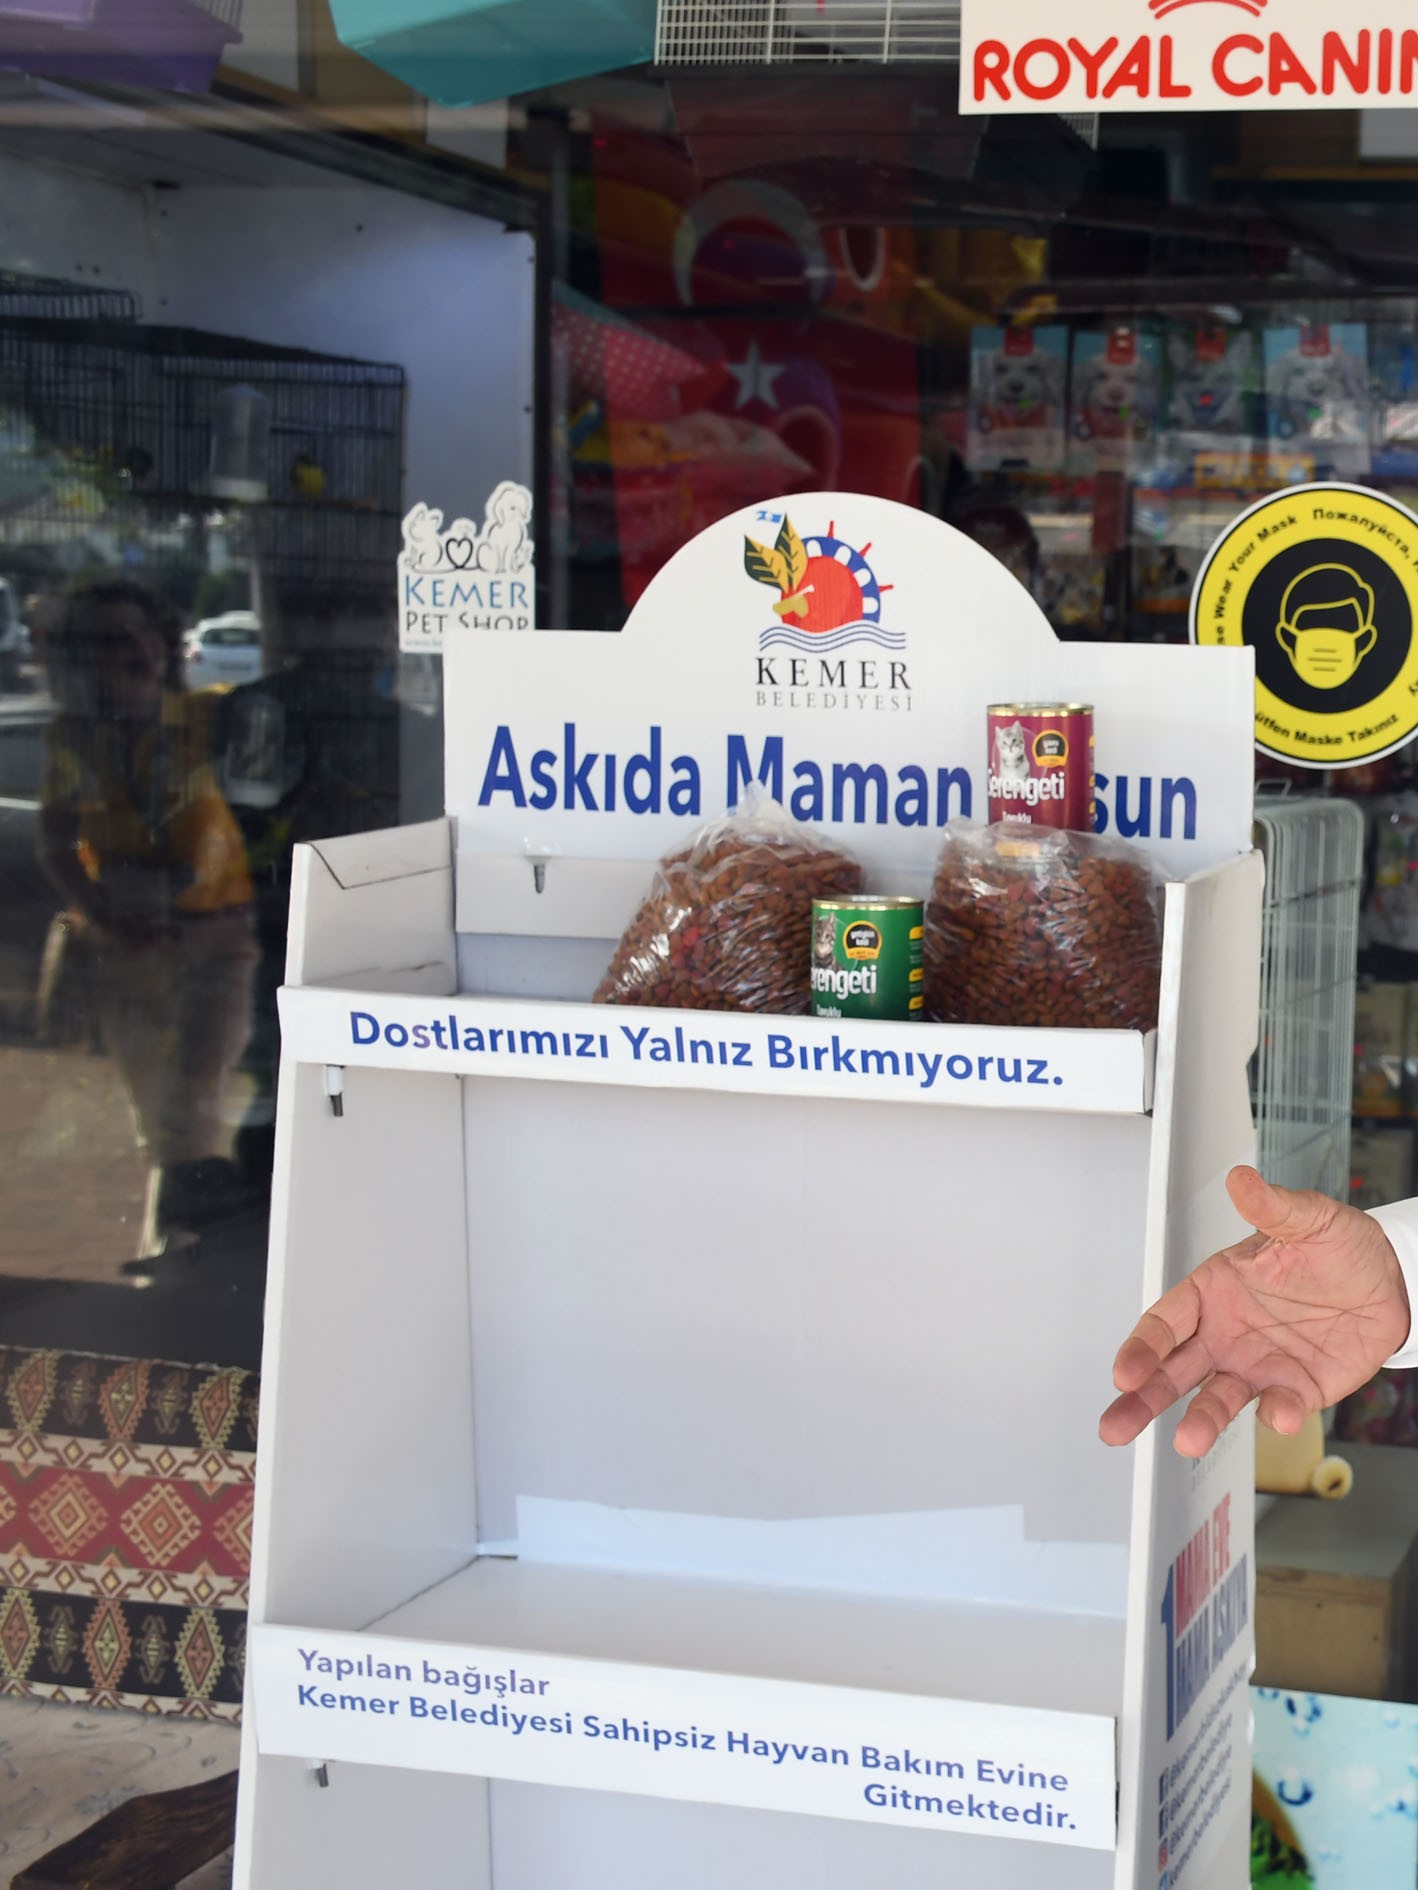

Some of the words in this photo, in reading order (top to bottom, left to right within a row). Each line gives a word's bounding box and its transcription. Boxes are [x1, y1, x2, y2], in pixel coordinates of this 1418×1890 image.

[973, 35, 1192, 102] ROYAL
[1214, 579, 1233, 620] Wear
[1229, 540, 1257, 573] Your
[1257, 515, 1297, 542] Mask
[404, 575, 529, 609] KEMER
[406, 611, 448, 634] PET
[458, 611, 529, 630] SHOP
[755, 656, 912, 690] KEMER
[755, 690, 912, 712] BELEDİYESİ
[1254, 712, 1290, 739] ütfen
[1294, 730, 1343, 745] Maske
[477, 722, 701, 816] Askıda
[726, 734, 973, 828] Maman
[1090, 772, 1197, 840] sun
[811, 965, 878, 1000] rengeti
[350, 1011, 609, 1059] Dostlarımızı
[620, 1025, 753, 1067] Yalnız
[767, 1034, 1064, 1088] Bırkmıyoruz.
[298, 1649, 412, 1682] Yapılan
[422, 1660, 550, 1698] bağışlar
[298, 1685, 400, 1715] Kemer
[409, 1696, 573, 1735] Belediyesi
[582, 1715, 716, 1751] Sahipsiz
[727, 1731, 849, 1765] Hayvan
[861, 1745, 965, 1779] Bakım
[976, 1759, 1069, 1792] Evine
[863, 1783, 1077, 1830] Gitmektedir.
